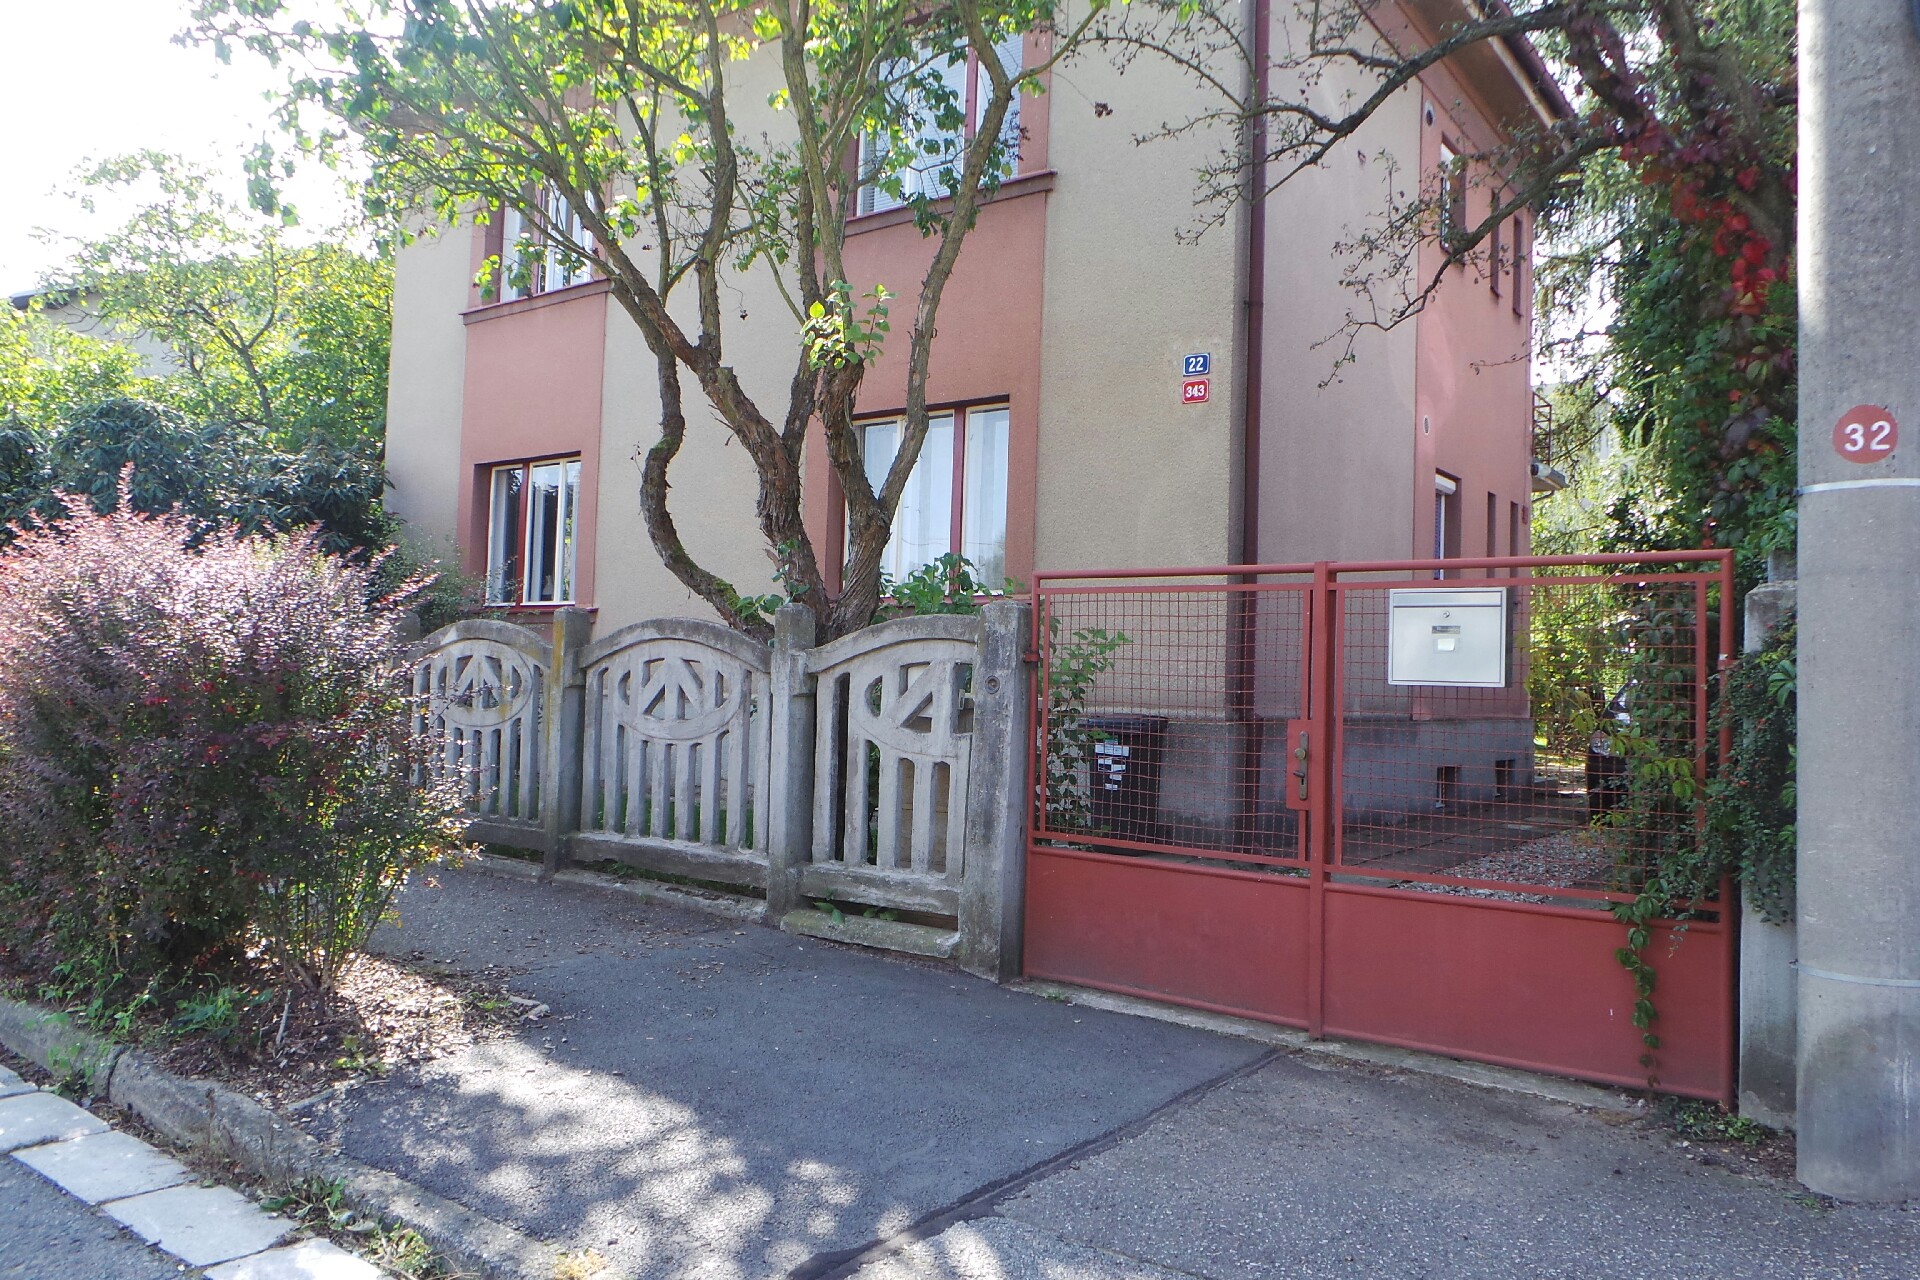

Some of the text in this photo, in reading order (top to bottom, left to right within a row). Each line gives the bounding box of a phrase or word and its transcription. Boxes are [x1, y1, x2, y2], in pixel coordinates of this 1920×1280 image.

[1188, 356, 1204, 372] 22
[1185, 384, 1205, 398] 343
[1844, 420, 1891, 452] 32
